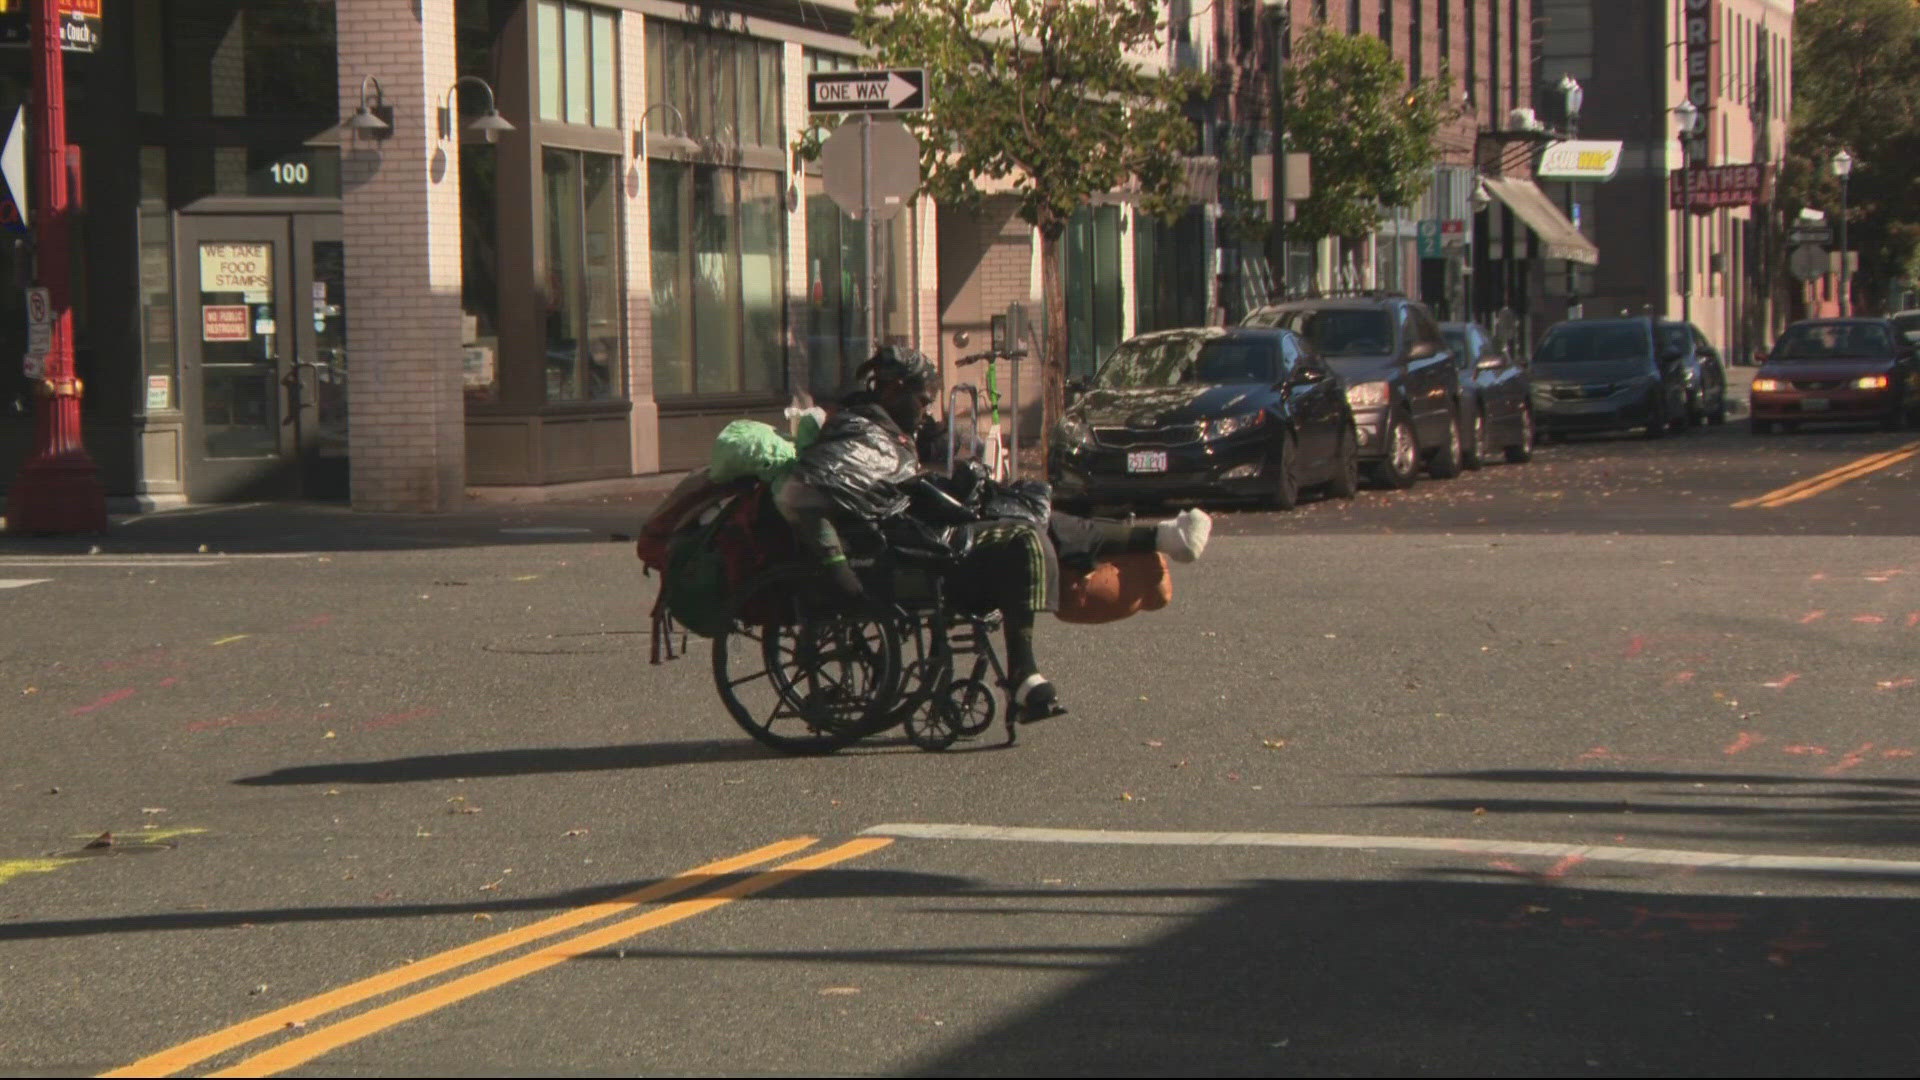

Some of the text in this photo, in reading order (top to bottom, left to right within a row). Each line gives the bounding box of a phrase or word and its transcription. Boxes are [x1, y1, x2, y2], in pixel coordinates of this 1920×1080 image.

[66, 22, 91, 43] Couch
[819, 81, 888, 100] ONE WAY
[1543, 149, 1614, 172] SUBWAY
[270, 162, 309, 184] 100
[1672, 167, 1759, 190] LEATHER
[204, 245, 263, 258] WE TAKE
[220, 262, 255, 273] FOOD
[215, 274, 268, 287] STAMPS
